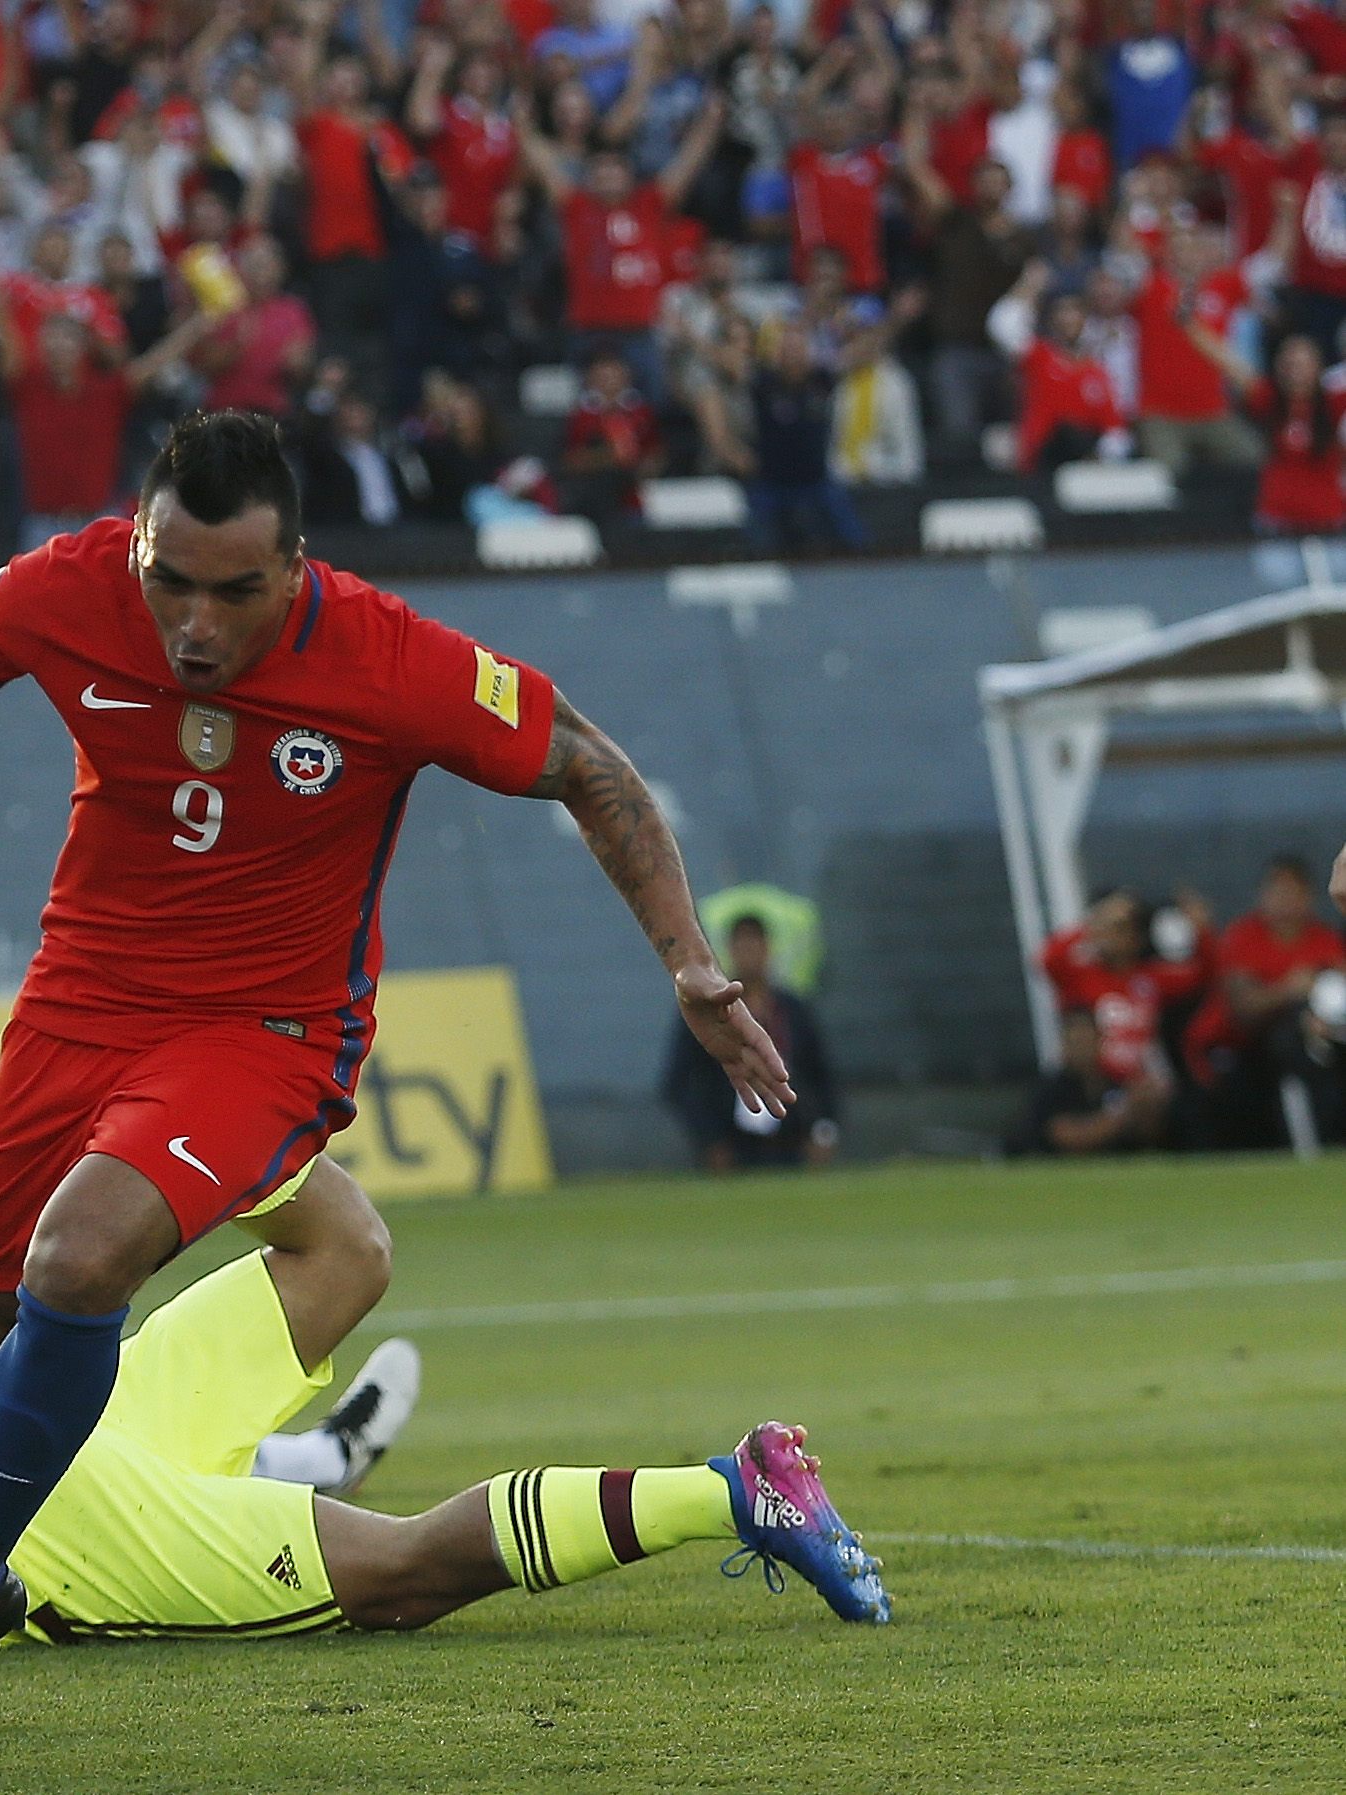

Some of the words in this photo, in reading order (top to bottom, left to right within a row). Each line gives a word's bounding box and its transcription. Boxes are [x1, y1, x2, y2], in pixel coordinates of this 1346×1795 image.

[490, 674, 502, 708] FIFA
[299, 784, 323, 795] CHILE
[172, 779, 223, 853] 9
